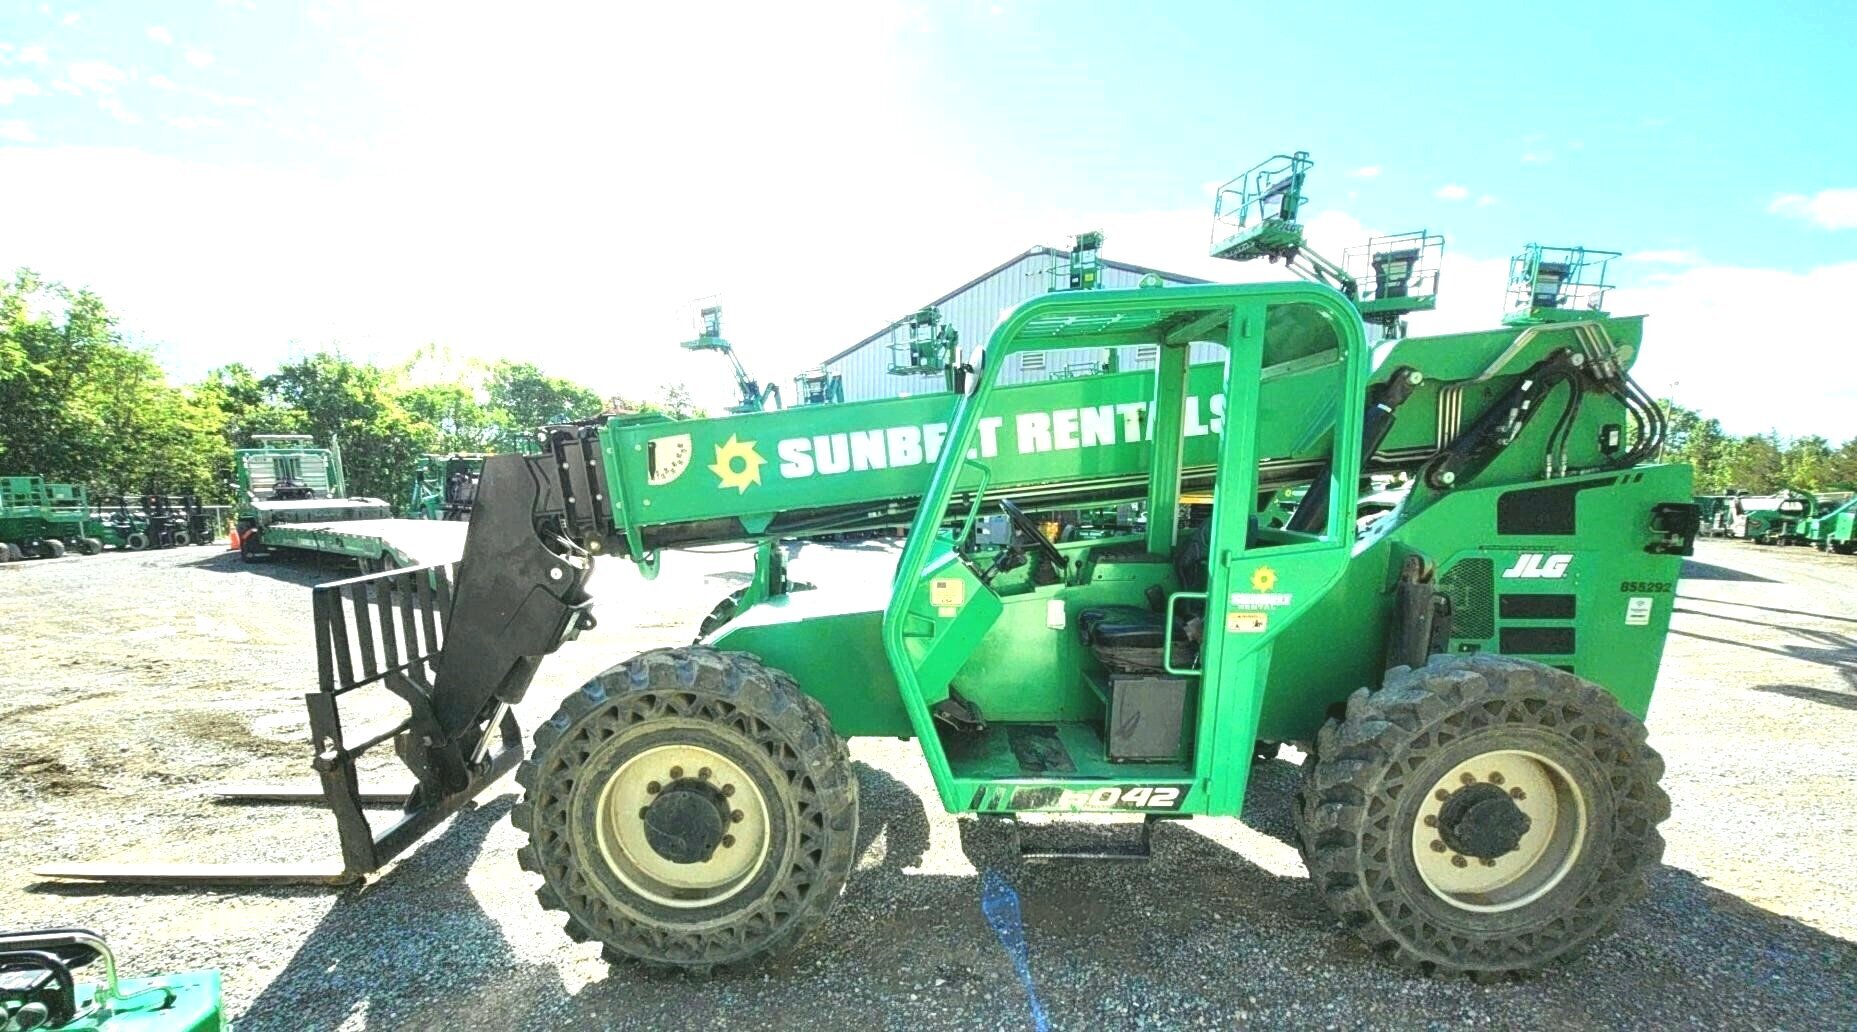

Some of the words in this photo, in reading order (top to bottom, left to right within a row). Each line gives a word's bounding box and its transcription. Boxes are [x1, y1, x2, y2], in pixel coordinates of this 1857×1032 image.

[777, 416, 1002, 479] SUNBET
[1015, 393, 1226, 455] RENTL
[1501, 553, 1574, 578] JLG
